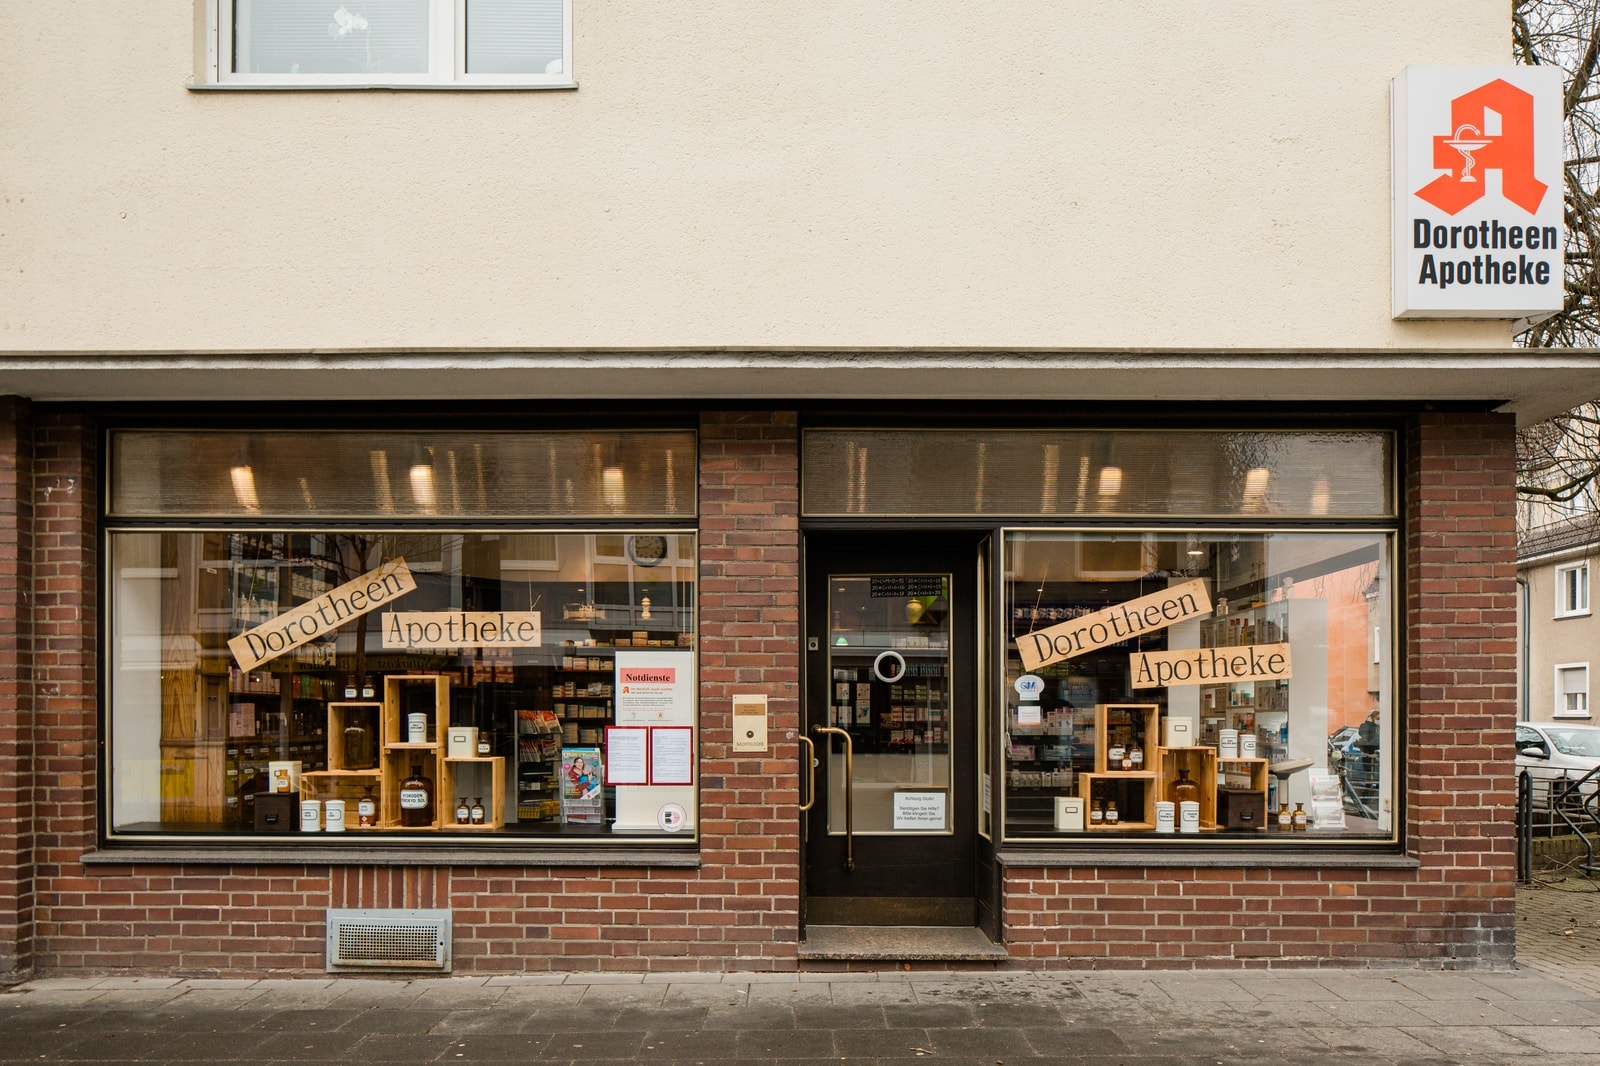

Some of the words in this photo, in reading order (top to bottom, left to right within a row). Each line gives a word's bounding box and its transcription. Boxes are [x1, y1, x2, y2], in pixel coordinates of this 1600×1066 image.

[1413, 218, 1557, 250] Dorotheen
[1418, 254, 1551, 289] Apotheke
[243, 572, 404, 663] Dorotheen
[387, 613, 535, 649] Apotheke
[1032, 592, 1200, 664] Dorotheen
[625, 674, 671, 682] Notdienste
[1136, 646, 1287, 687] Apotheke
